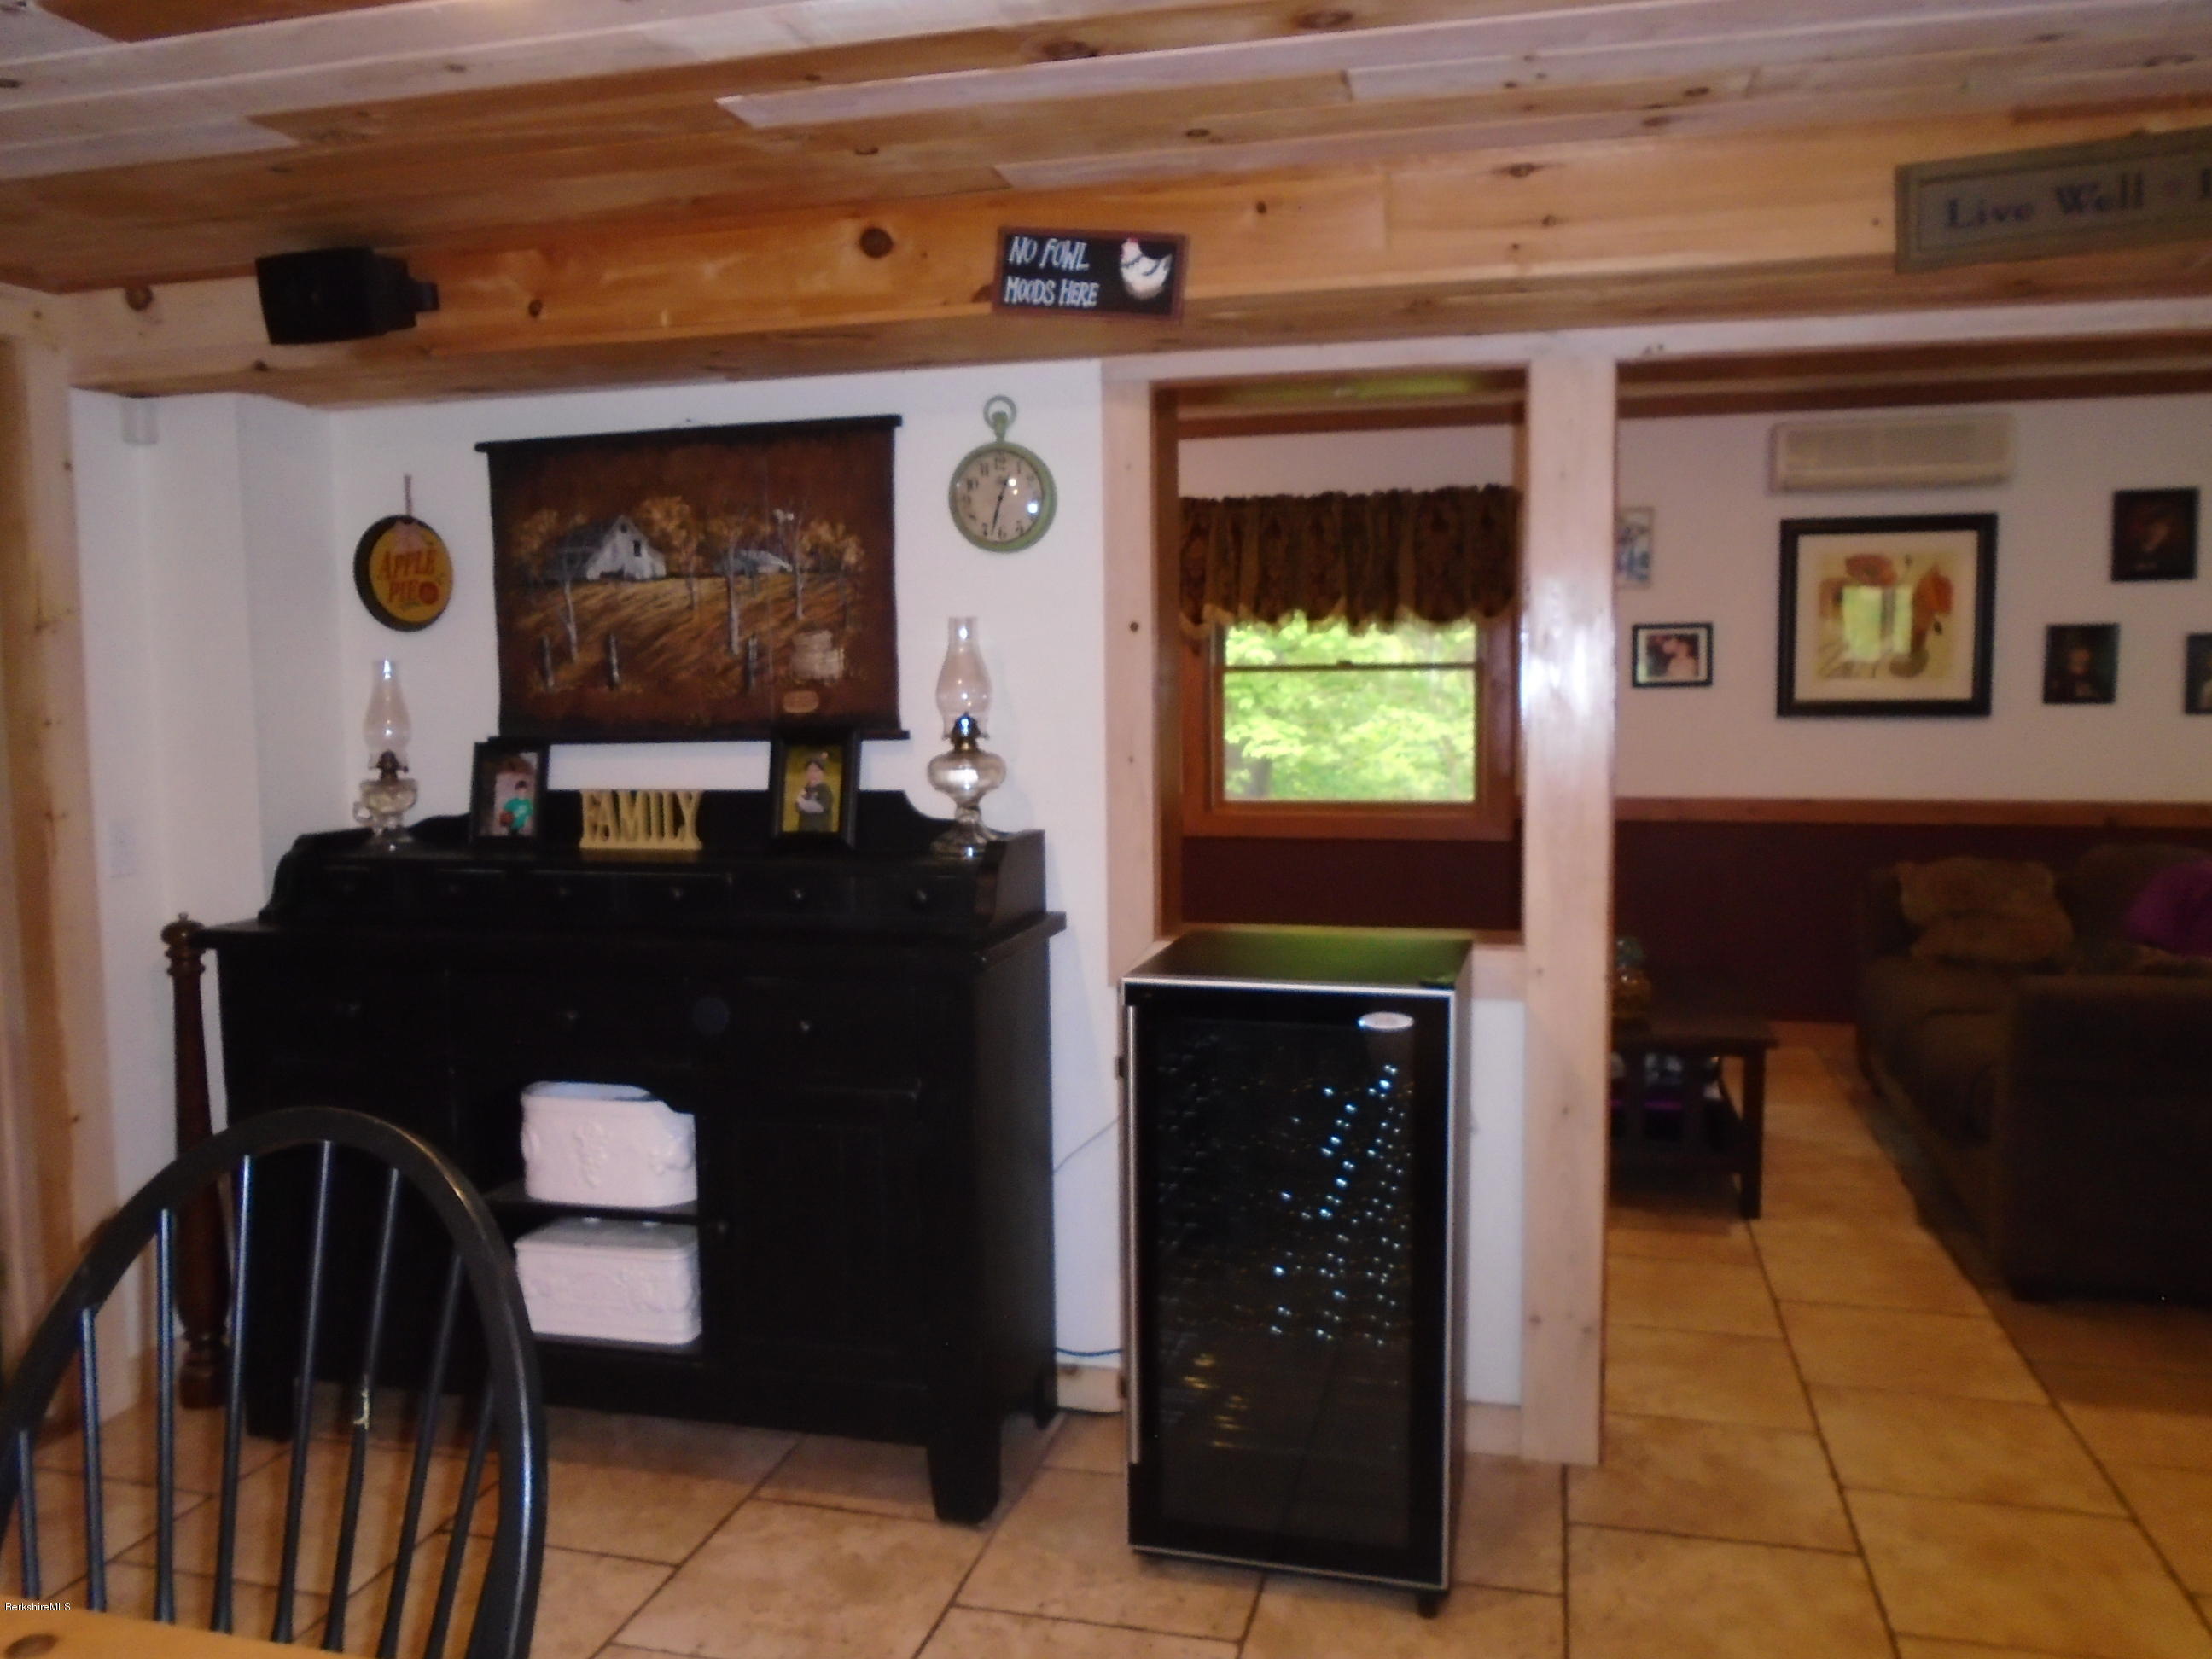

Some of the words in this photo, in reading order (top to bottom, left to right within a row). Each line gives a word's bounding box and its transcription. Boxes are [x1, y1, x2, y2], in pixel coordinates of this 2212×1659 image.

[2055, 172, 2143, 214] Well
[1008, 236, 1039, 265] NO
[1039, 237, 1090, 271] FOWL
[1004, 275, 1055, 306] MOODS
[1057, 277, 1100, 308] HERE
[579, 789, 702, 849] FAMILY
